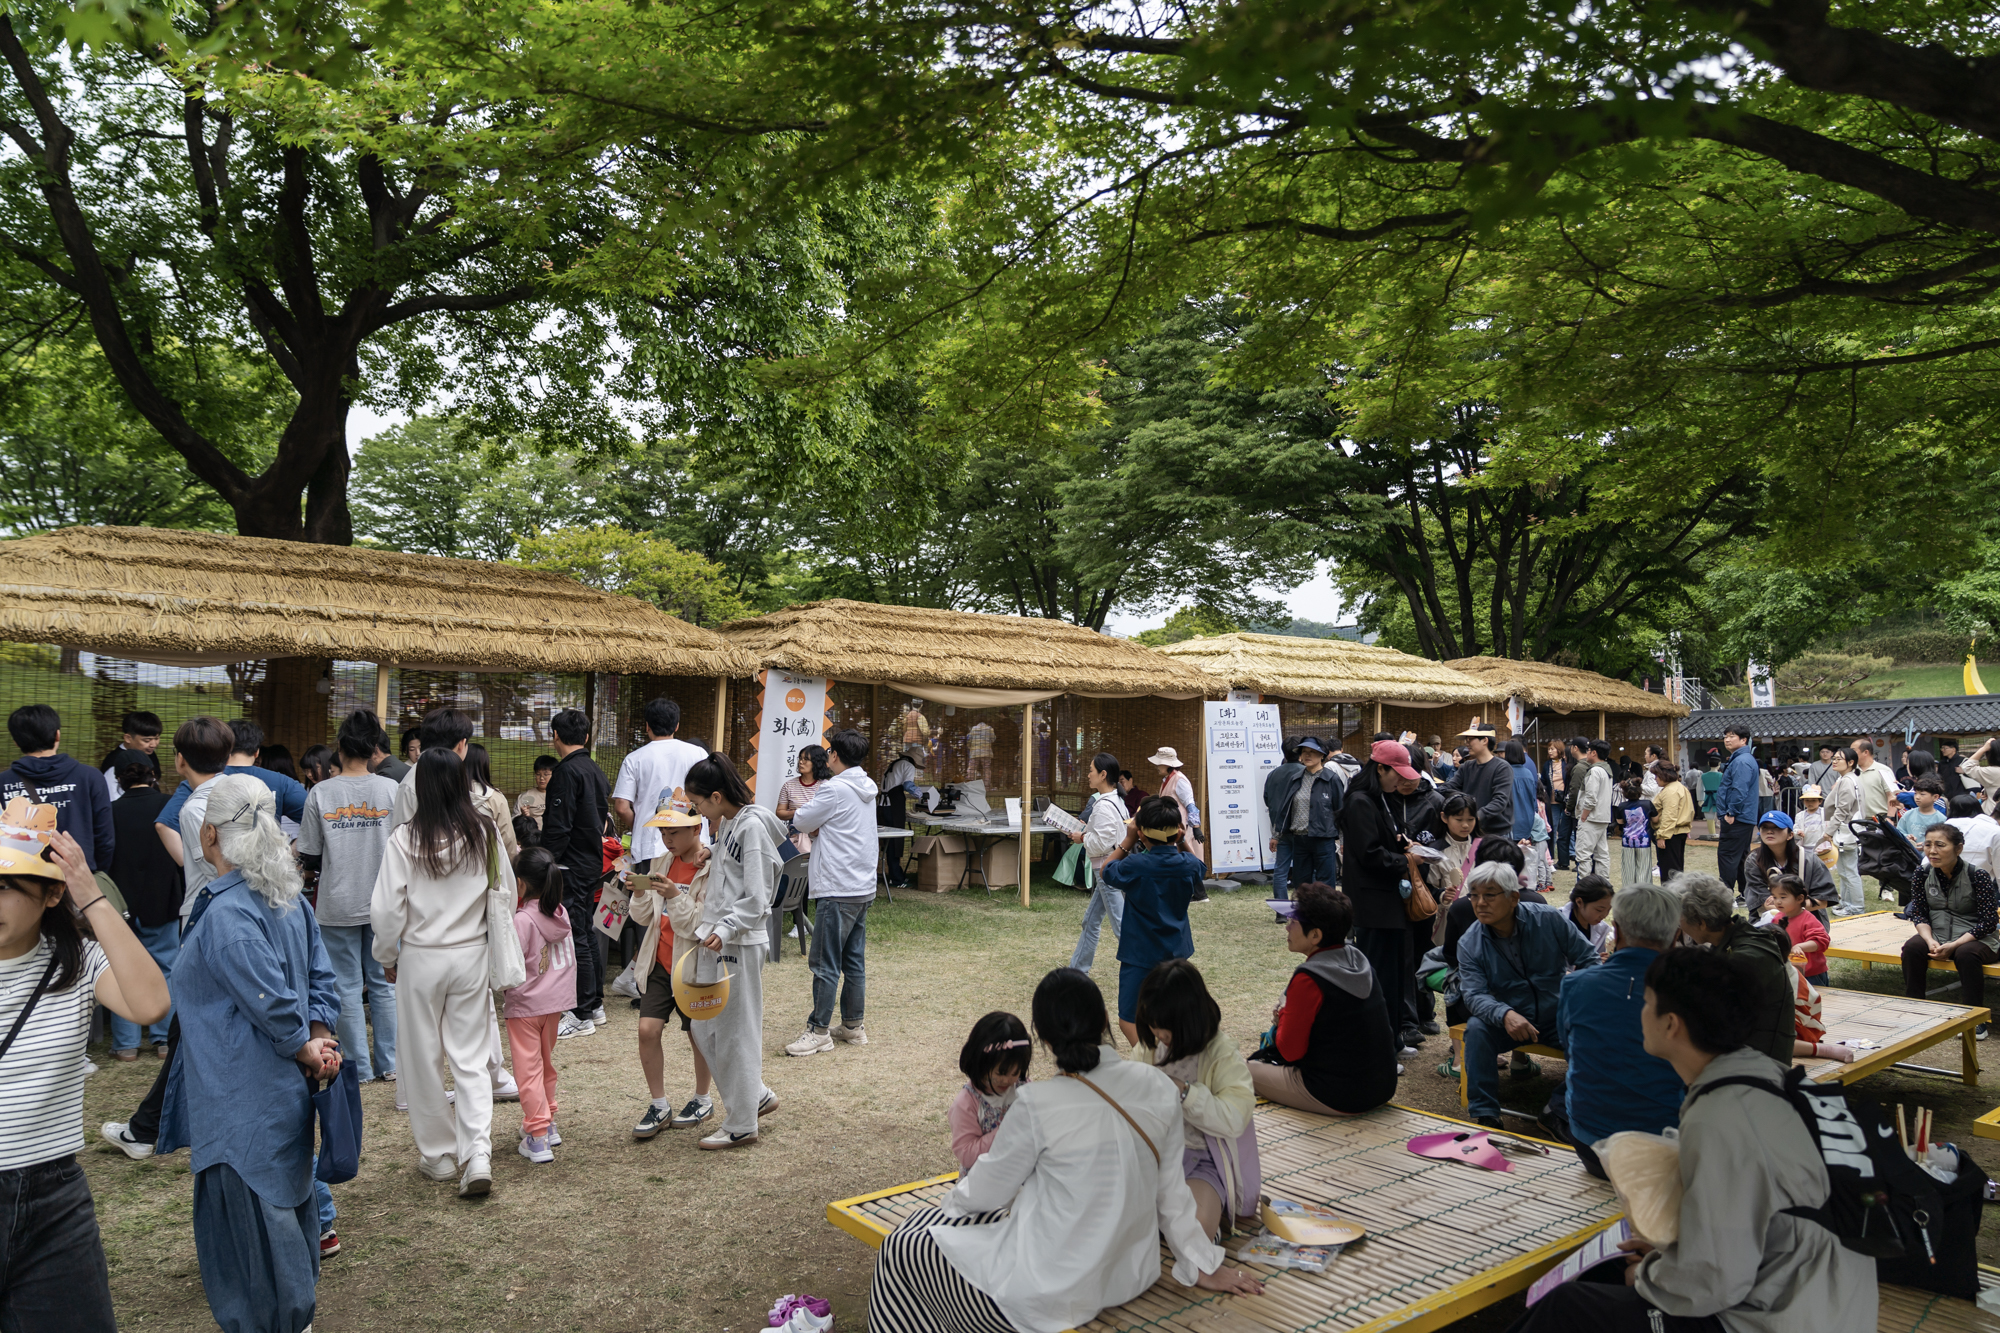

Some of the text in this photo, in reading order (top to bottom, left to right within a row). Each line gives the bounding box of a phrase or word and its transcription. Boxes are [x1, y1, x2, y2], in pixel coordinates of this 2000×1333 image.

[785, 744, 797, 777] 그림으
[3, 784, 77, 800] HEATHIEST
[4, 782, 26, 791] THE
[332, 820, 382, 829] OCEAN PACIFIC
